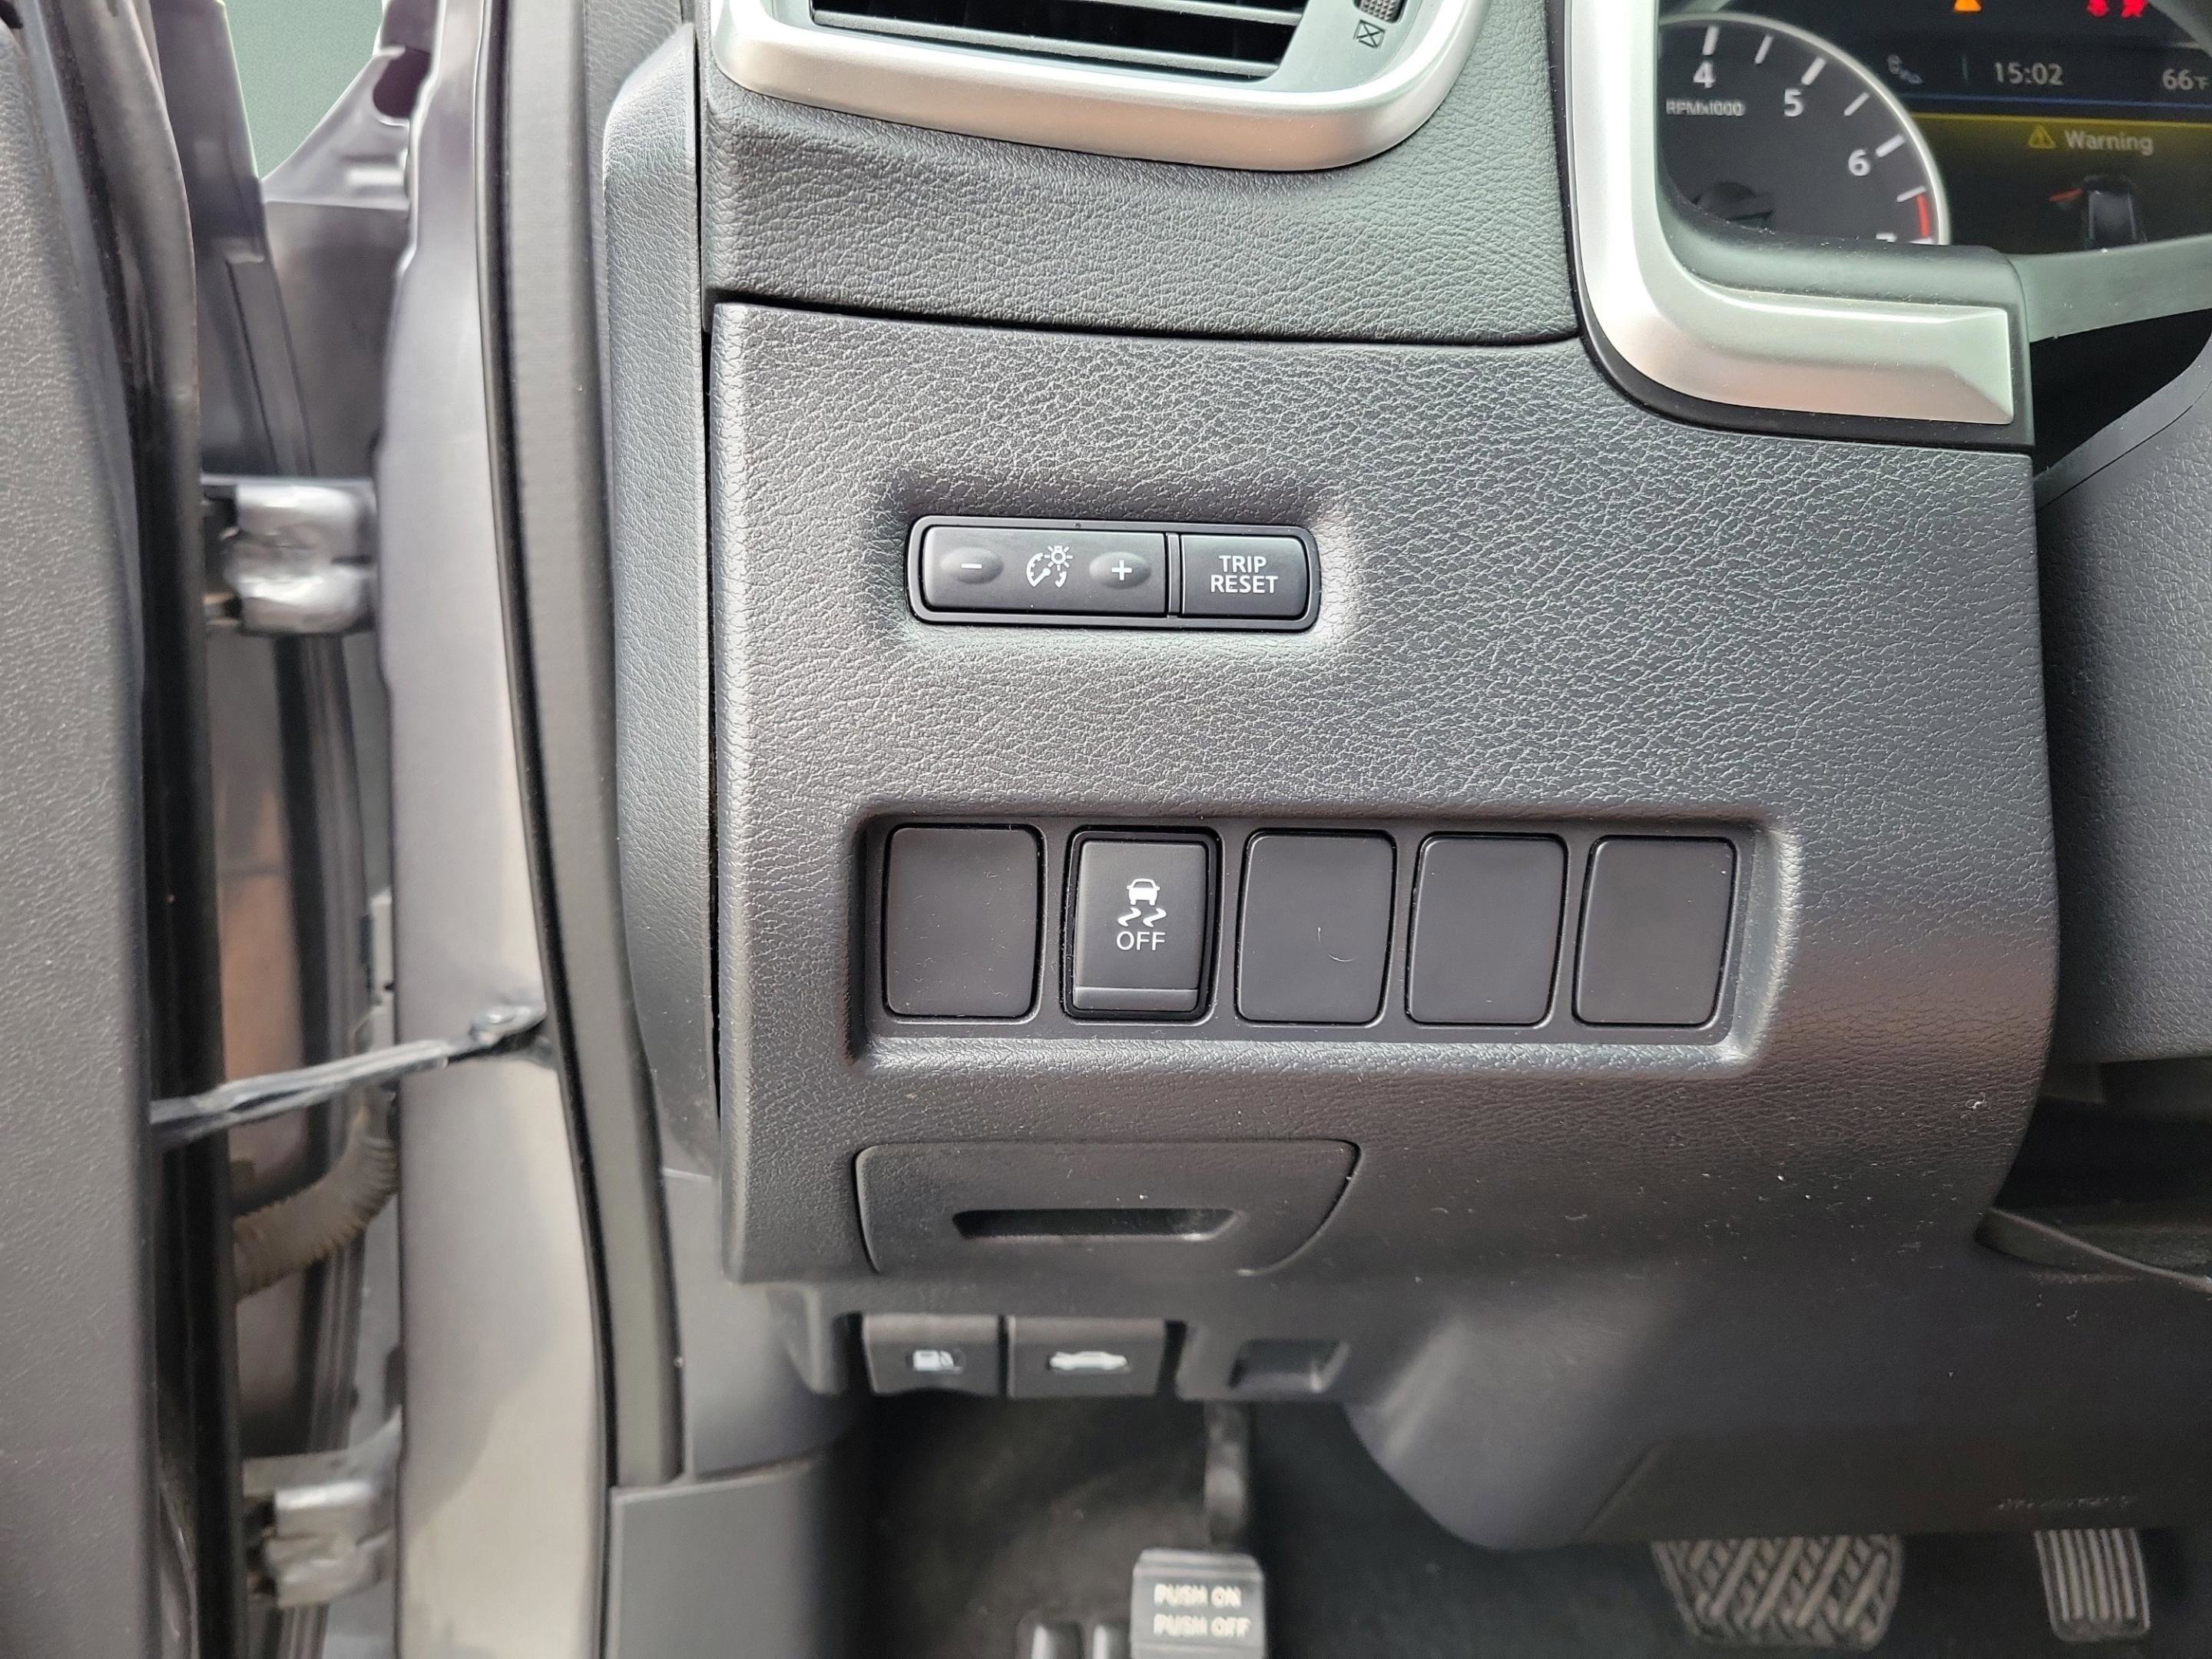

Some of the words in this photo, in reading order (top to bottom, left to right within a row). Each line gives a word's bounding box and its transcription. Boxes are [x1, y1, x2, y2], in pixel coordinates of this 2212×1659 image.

[1694, 61, 1716, 88] 4
[1995, 62, 2064, 86] 15:02
[1784, 89, 1804, 117] 5
[2065, 131, 2153, 155] Warning
[1848, 150, 1870, 177] 6
[1219, 555, 1267, 573] TRIP
[1210, 575, 1278, 594] RESET
[1116, 931, 1165, 950] OFF
[1154, 1584, 1208, 1607] PUSH
[1211, 1587, 1242, 1609] ON
[1154, 1613, 1207, 1637] PUSH
[1211, 1616, 1252, 1637] OFF
